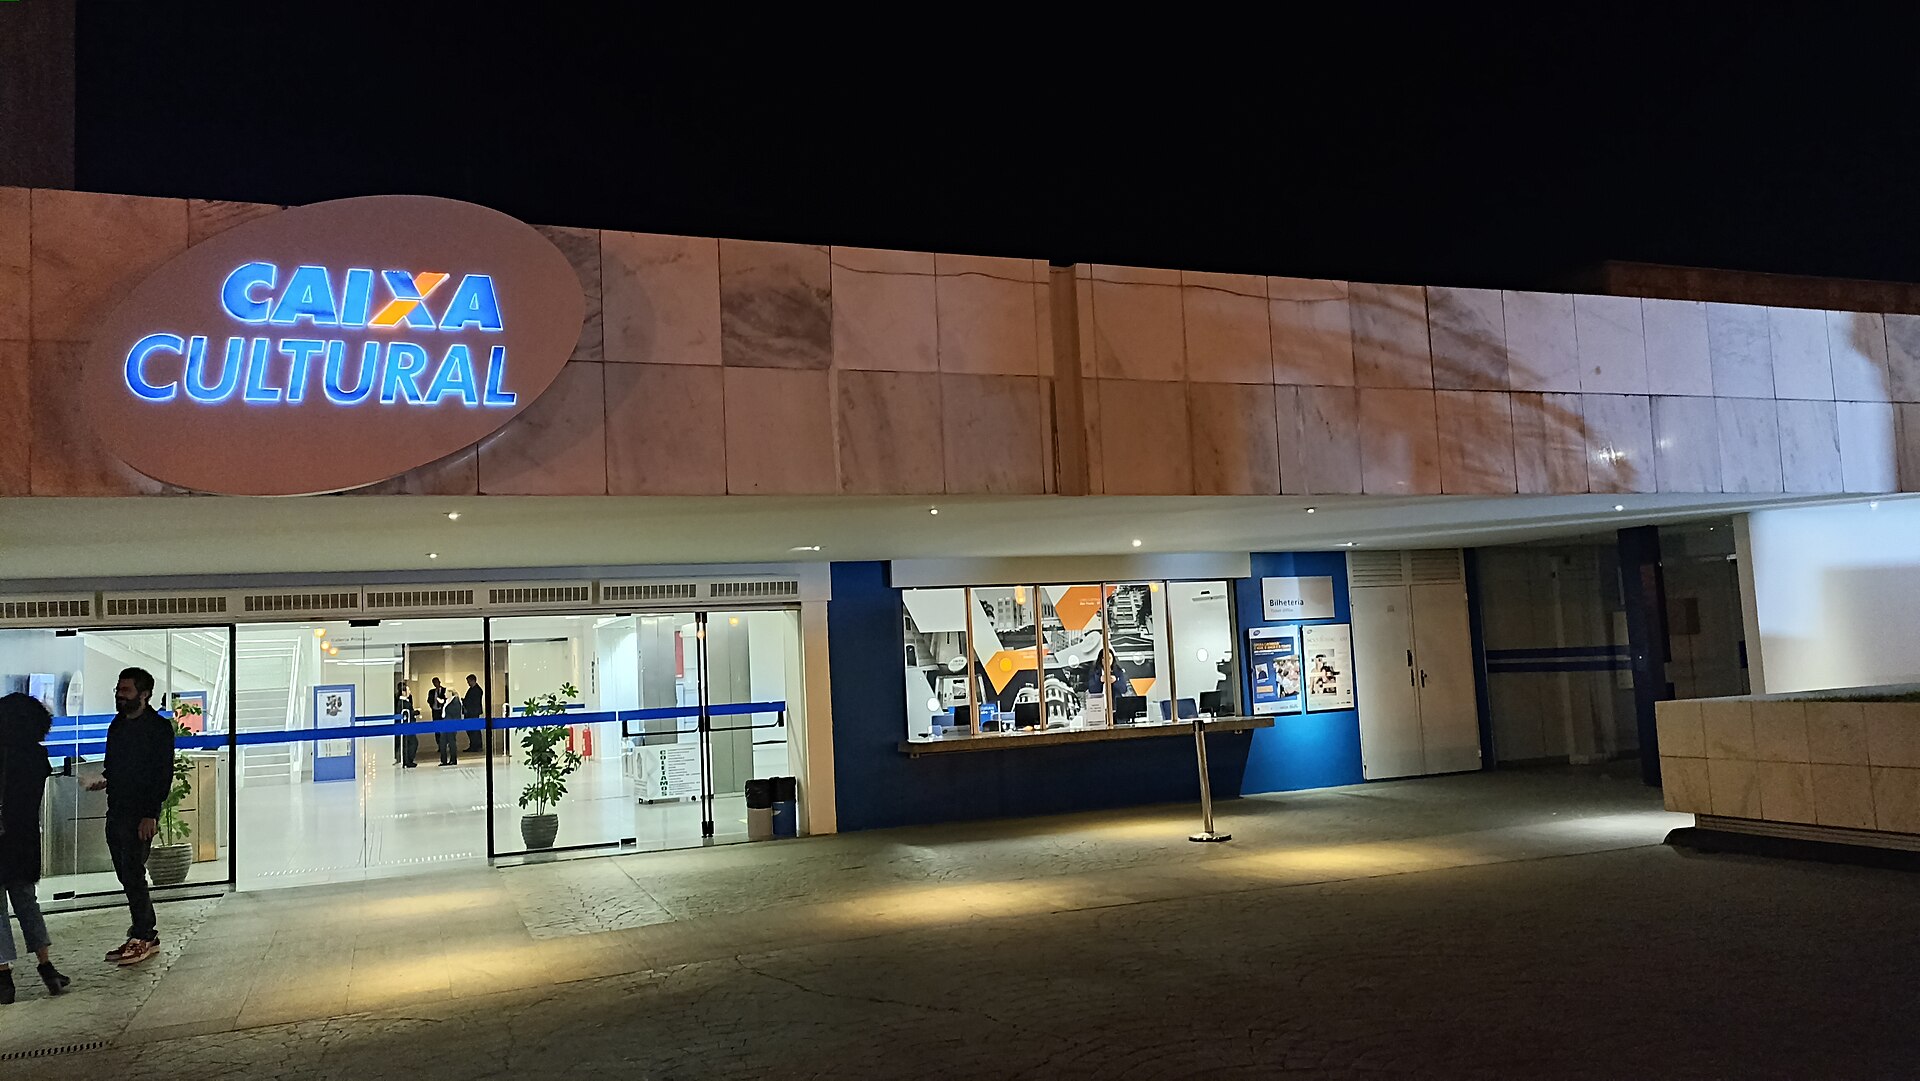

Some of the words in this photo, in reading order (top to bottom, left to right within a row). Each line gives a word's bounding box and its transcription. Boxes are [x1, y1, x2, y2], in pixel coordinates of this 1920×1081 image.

[221, 261, 504, 331] CAIXA
[124, 333, 517, 405] CULTURAL
[1270, 599, 1304, 607] Bilheteria
[660, 750, 668, 796] COLETAMOS
